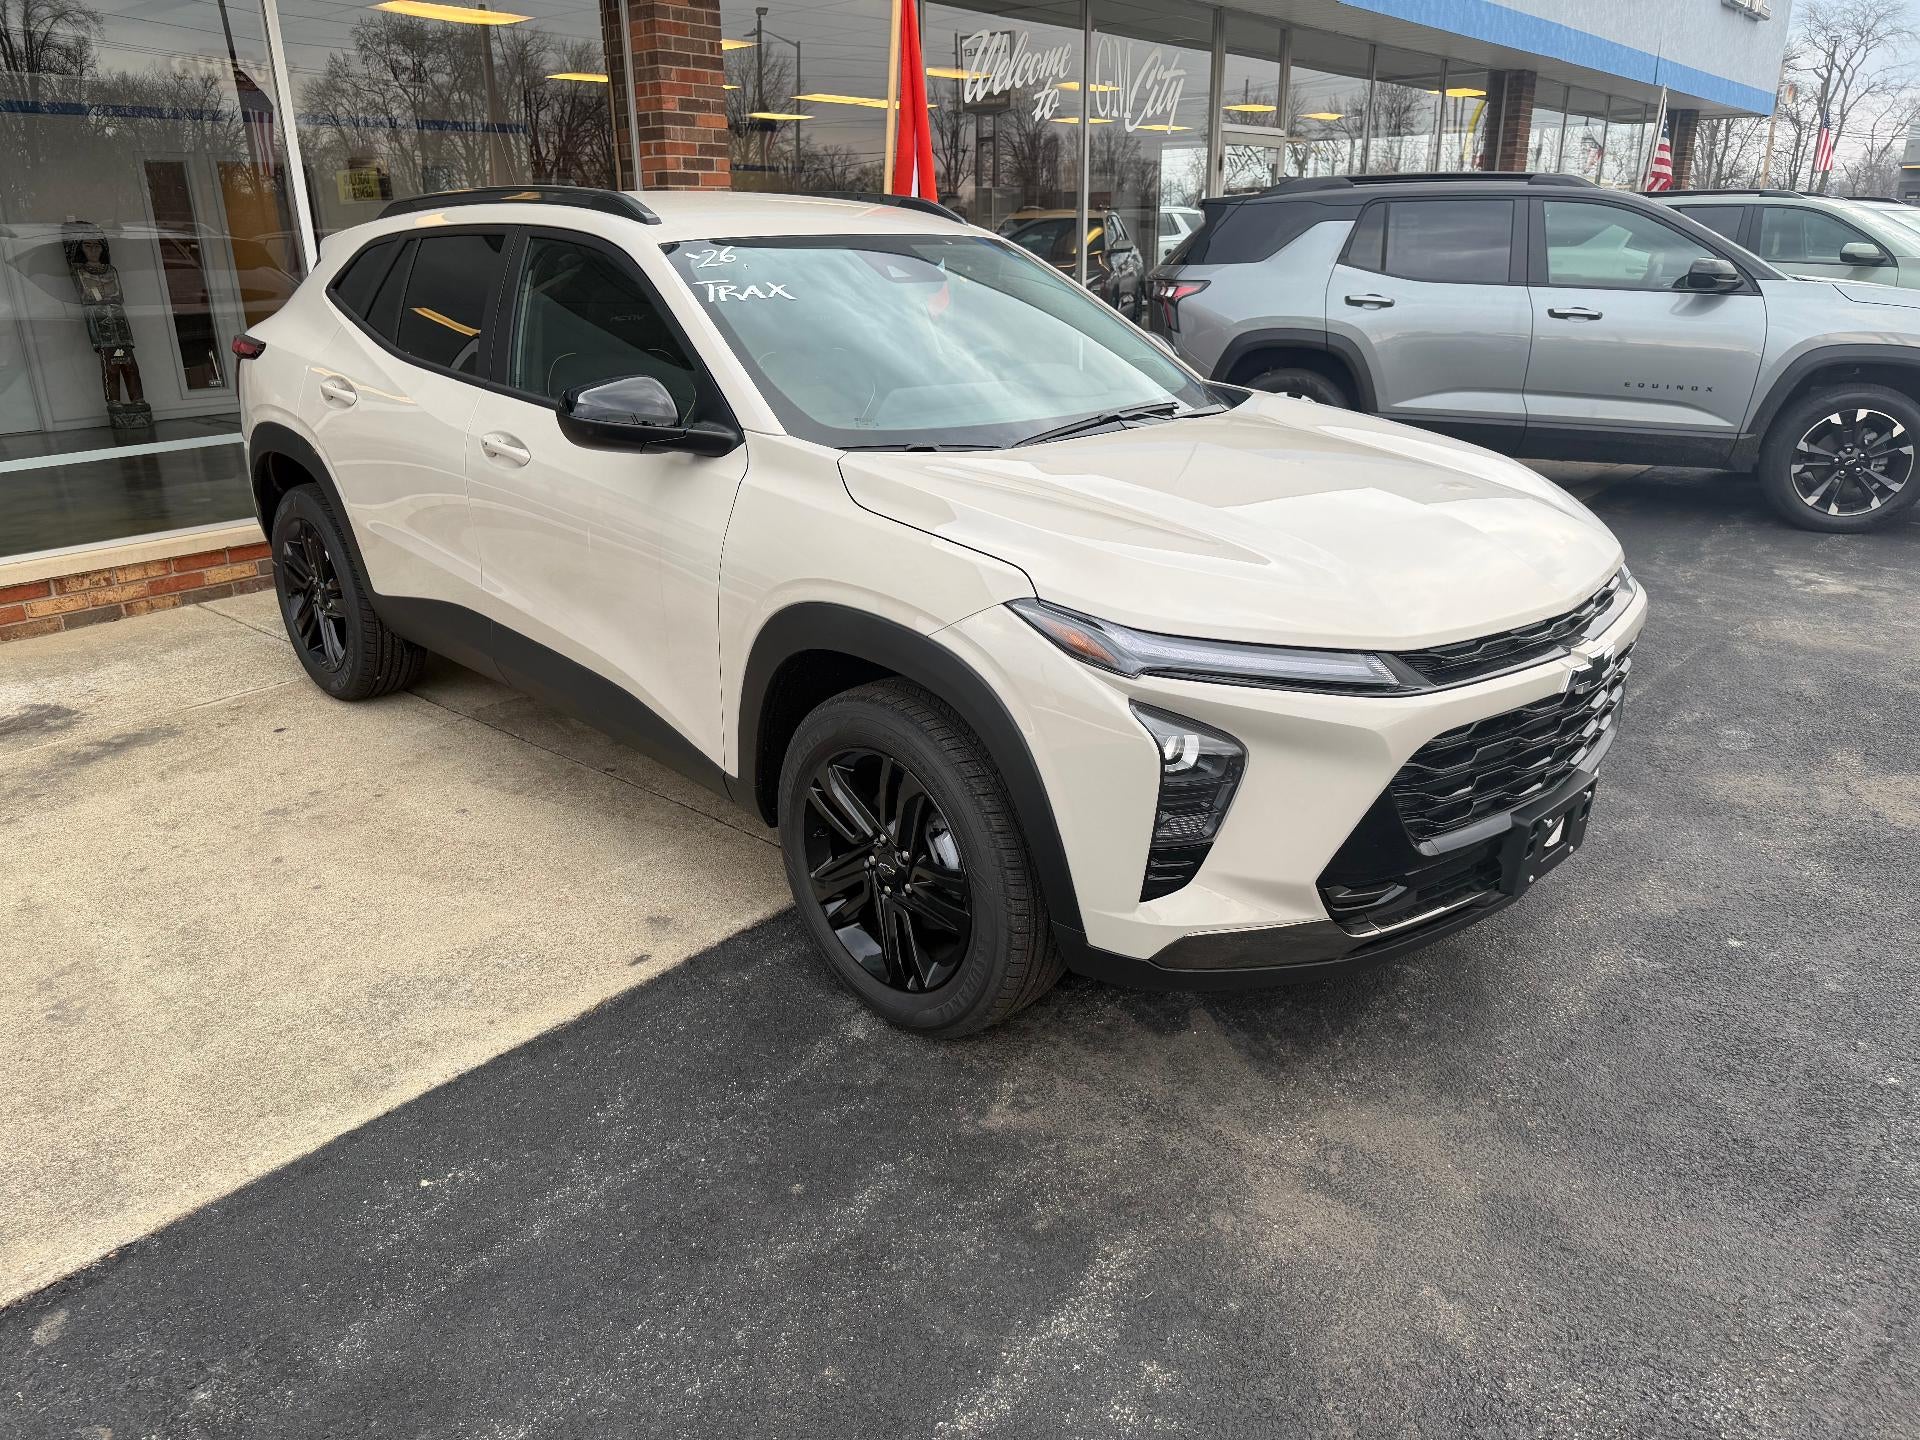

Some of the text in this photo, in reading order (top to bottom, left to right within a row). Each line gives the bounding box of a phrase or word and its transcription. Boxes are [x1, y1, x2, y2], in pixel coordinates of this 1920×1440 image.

[962, 29, 1072, 103] Welcome
[1095, 35, 1187, 135] GM City
[1032, 77, 1060, 122] to
[693, 280, 797, 302] TRAX
[1624, 381, 1713, 393] EQUINOX
